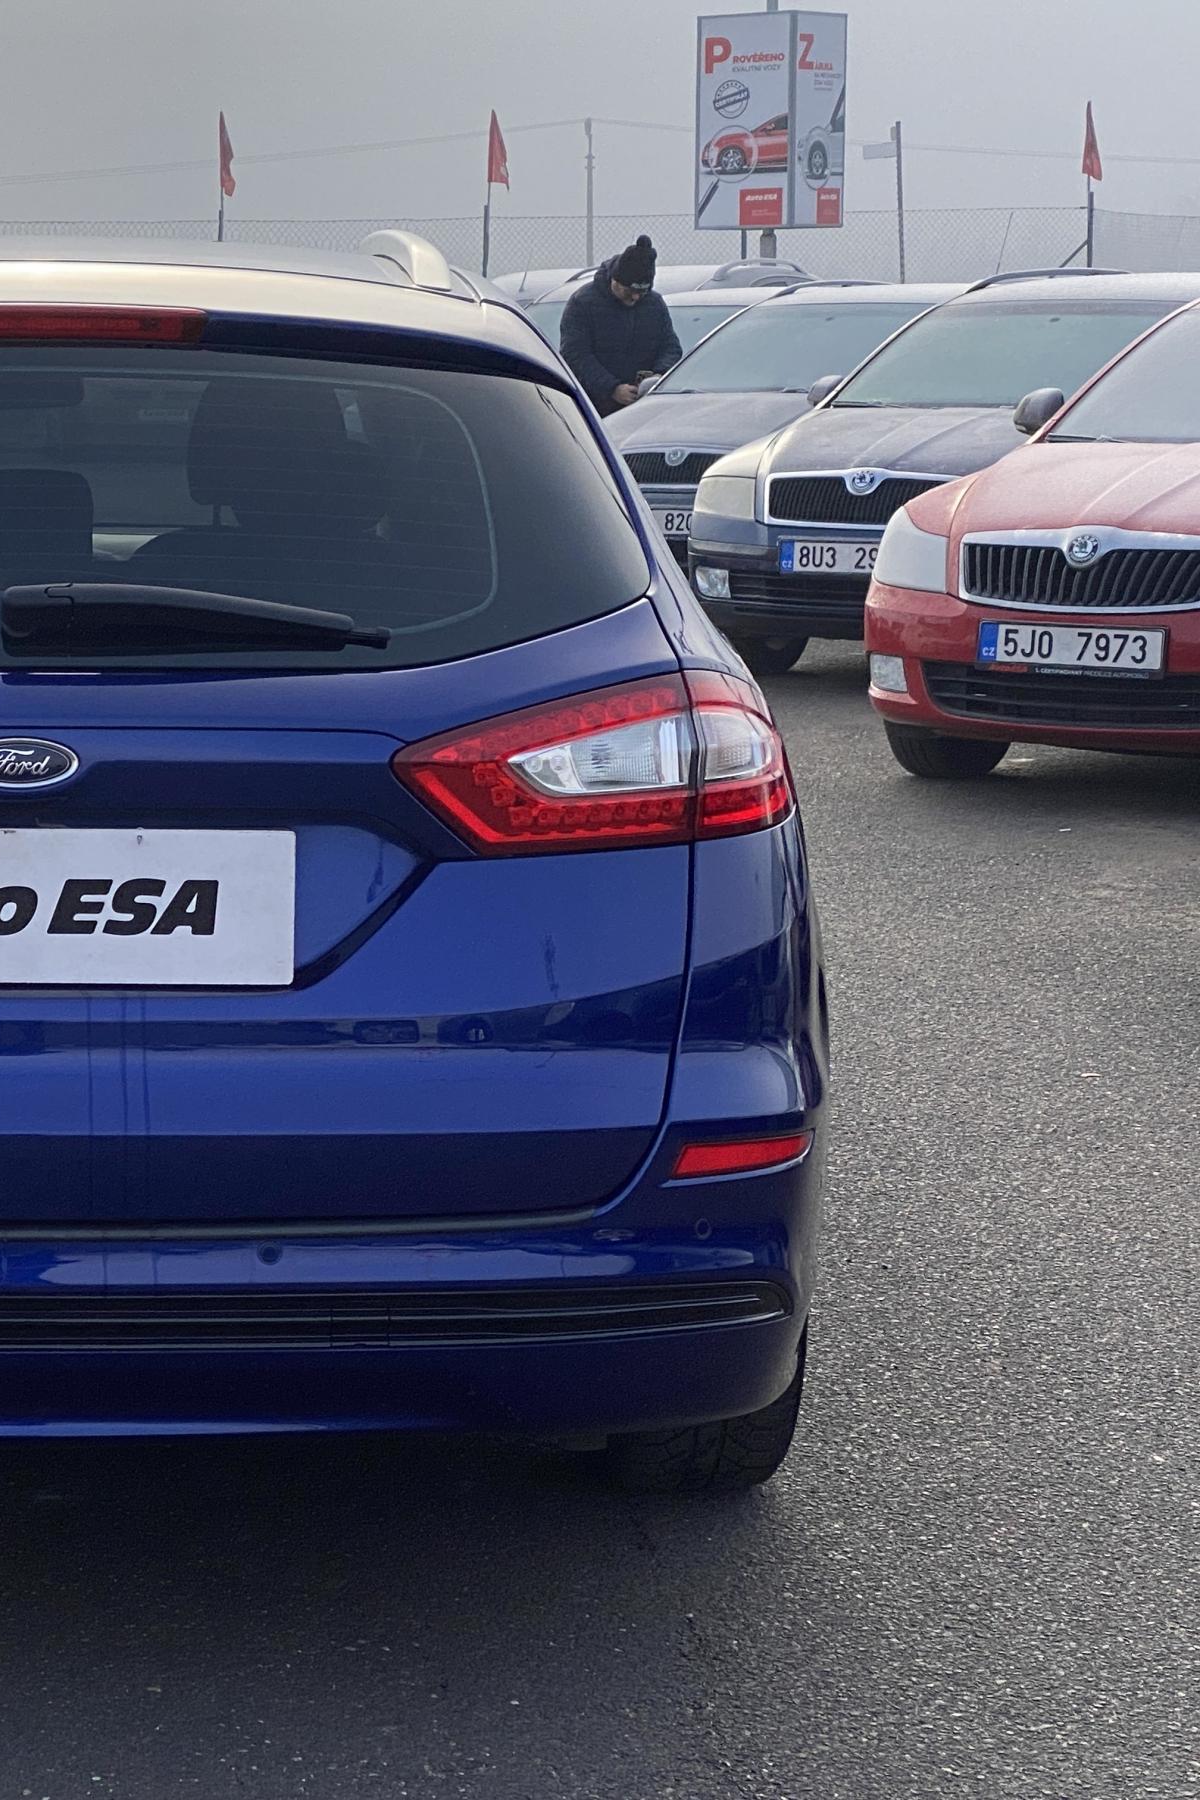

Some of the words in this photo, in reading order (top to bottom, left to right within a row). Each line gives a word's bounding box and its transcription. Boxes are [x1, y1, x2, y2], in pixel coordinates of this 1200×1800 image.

[799, 545, 837, 568] 8U3
[982, 646, 995, 656] CZ
[1003, 629, 1053, 659] 5J0
[1076, 632, 1148, 664] 7973
[46, 878, 220, 936] ESA
